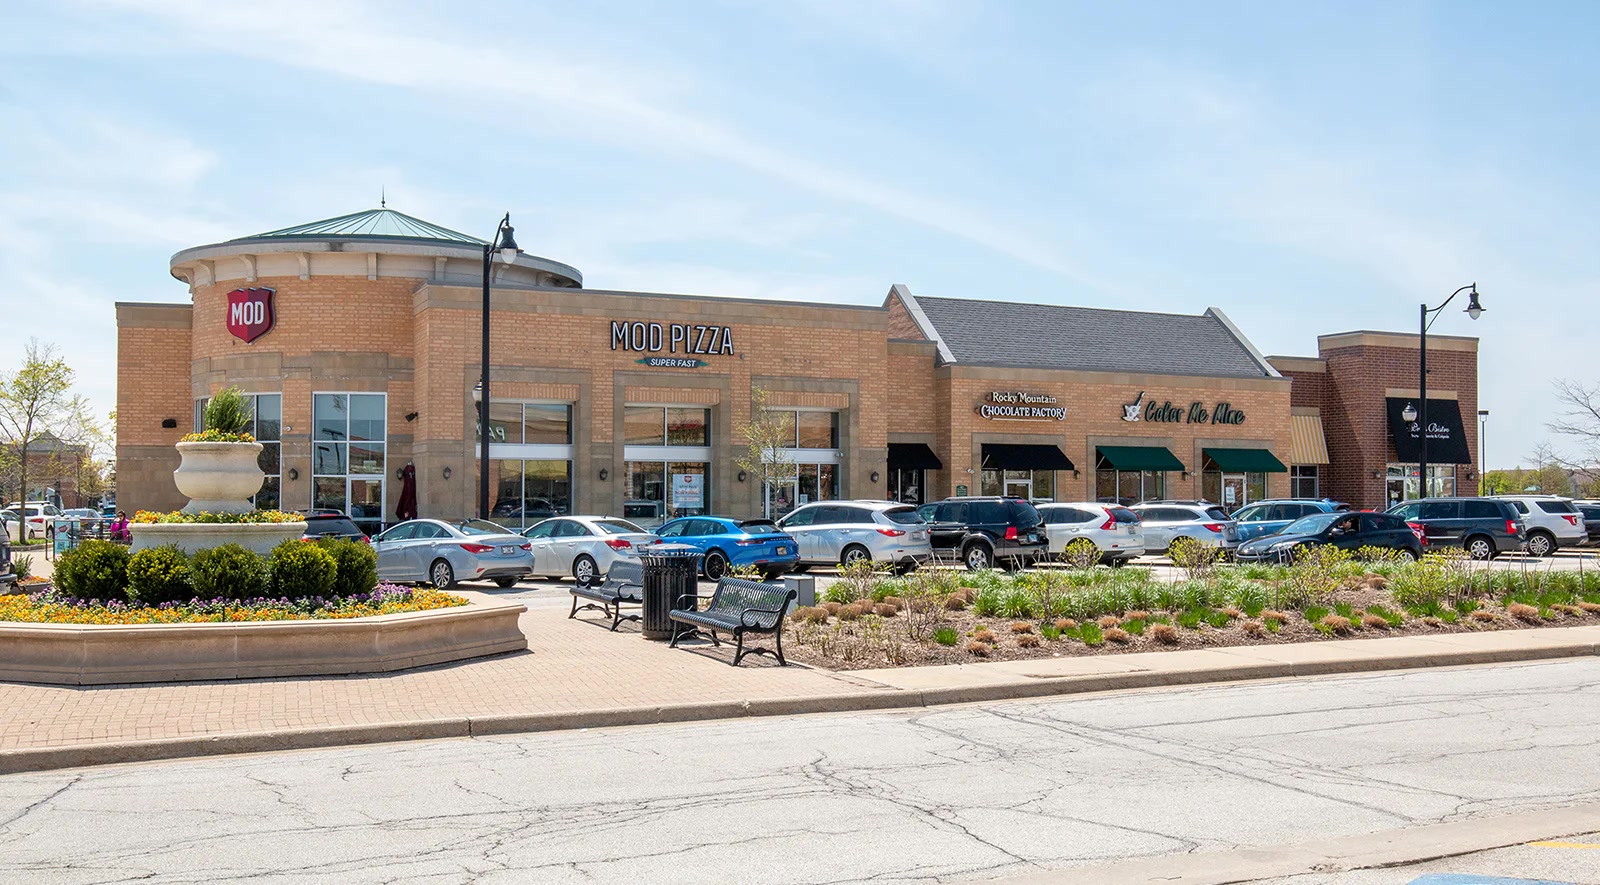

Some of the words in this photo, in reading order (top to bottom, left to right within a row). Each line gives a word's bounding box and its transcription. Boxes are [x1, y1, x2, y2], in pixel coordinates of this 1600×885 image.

[231, 301, 264, 326] MOD
[611, 321, 663, 352] MOD
[670, 324, 734, 355] PIZZA
[650, 358, 676, 367] SUPER
[677, 359, 697, 368] FAST
[992, 391, 1017, 404] Rocky
[1018, 392, 1057, 404] Mountain
[981, 405, 1030, 419] CHOCOLATE
[1031, 407, 1068, 421] FACTORY
[1145, 401, 1184, 422] Color
[1187, 402, 1208, 424] Me
[1211, 403, 1246, 425] Mine
